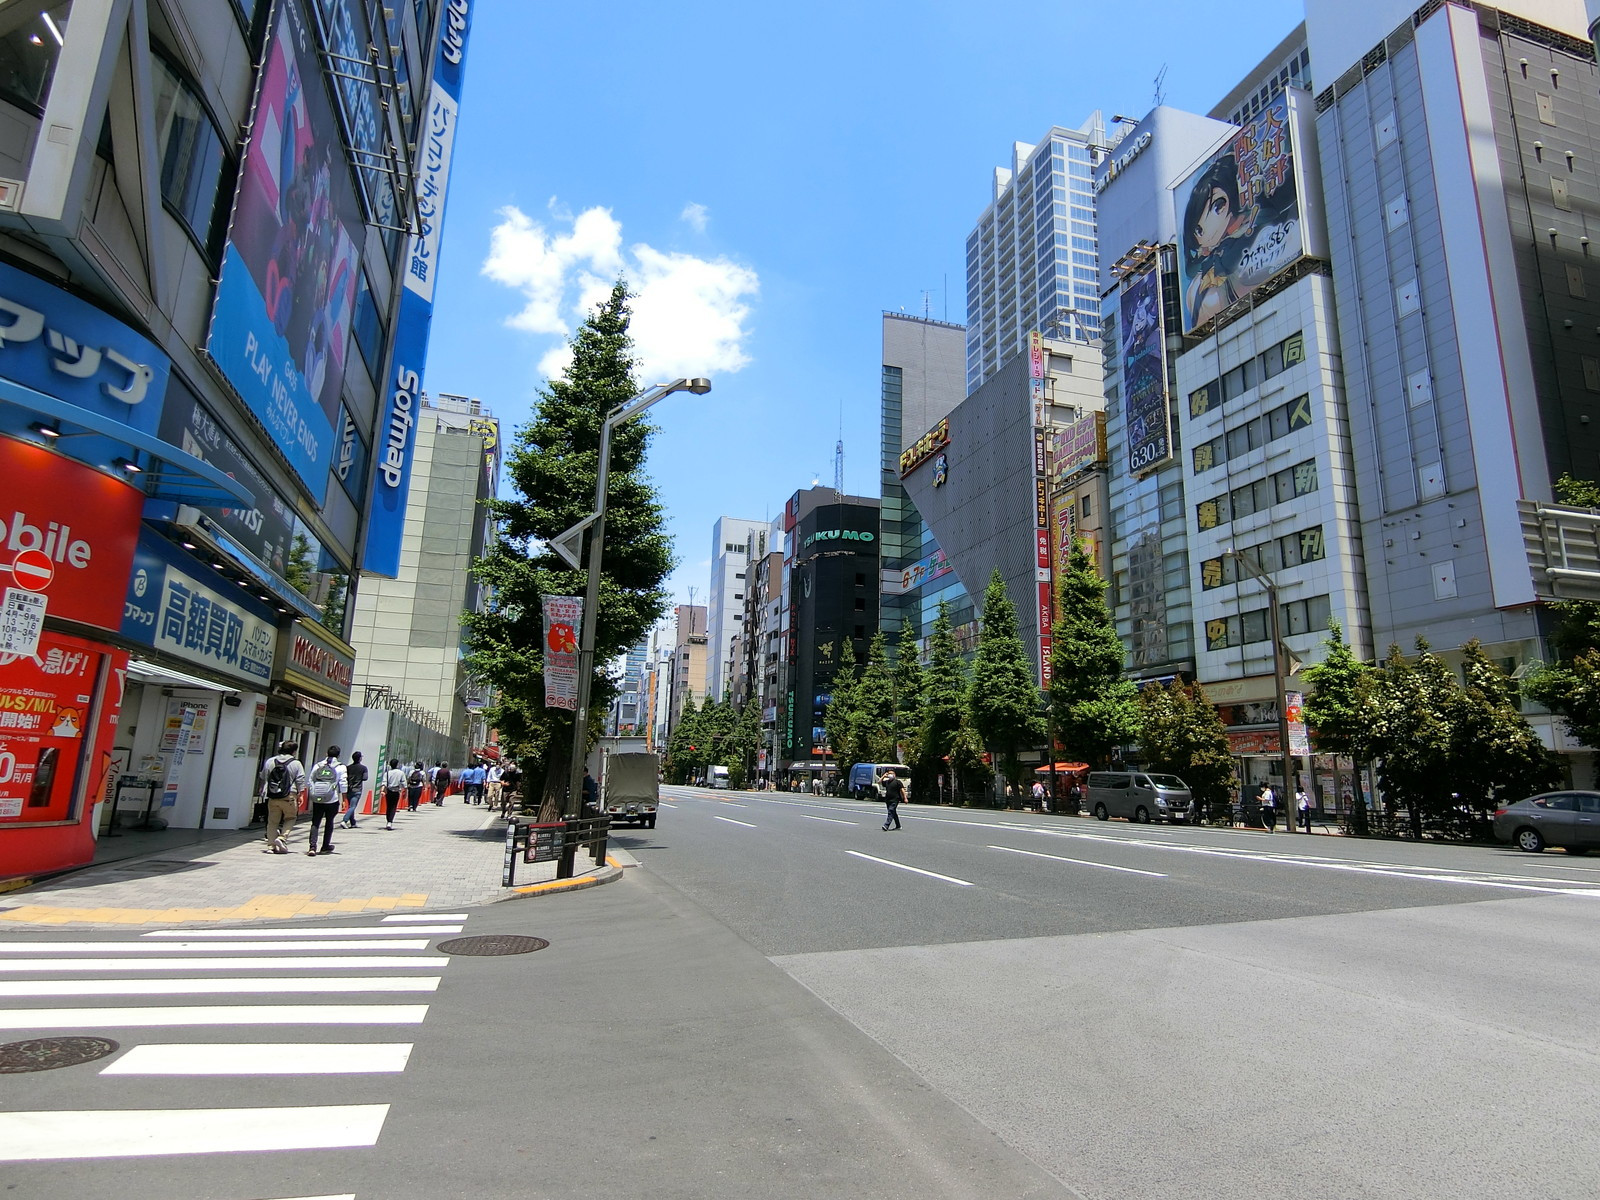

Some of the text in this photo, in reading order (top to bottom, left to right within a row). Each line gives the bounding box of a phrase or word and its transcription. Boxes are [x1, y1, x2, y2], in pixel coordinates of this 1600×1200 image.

[1094, 131, 1151, 194] animate
[1258, 106, 1289, 197] 大好評
[244, 331, 319, 463] PLAY NEVER ENDS
[380, 364, 419, 488] Sofmap
[1130, 442, 1156, 469] 6.30
[0, 511, 92, 569] bile
[803, 529, 875, 549] TSUKUMO
[9, 592, 44, 606] 自転車を除く
[1041, 604, 1049, 628] AKIBA
[160, 579, 244, 667] 高額買取
[251, 625, 271, 645] パソコン
[242, 639, 272, 665] スマホ・カメラ
[1042, 645, 1051, 679] ISLAND
[0, 711, 41, 729] 開始!!
[180, 701, 209, 709] iPhone
[786, 690, 795, 749] TSUKUMO
[104, 756, 123, 804] Y!mobile
